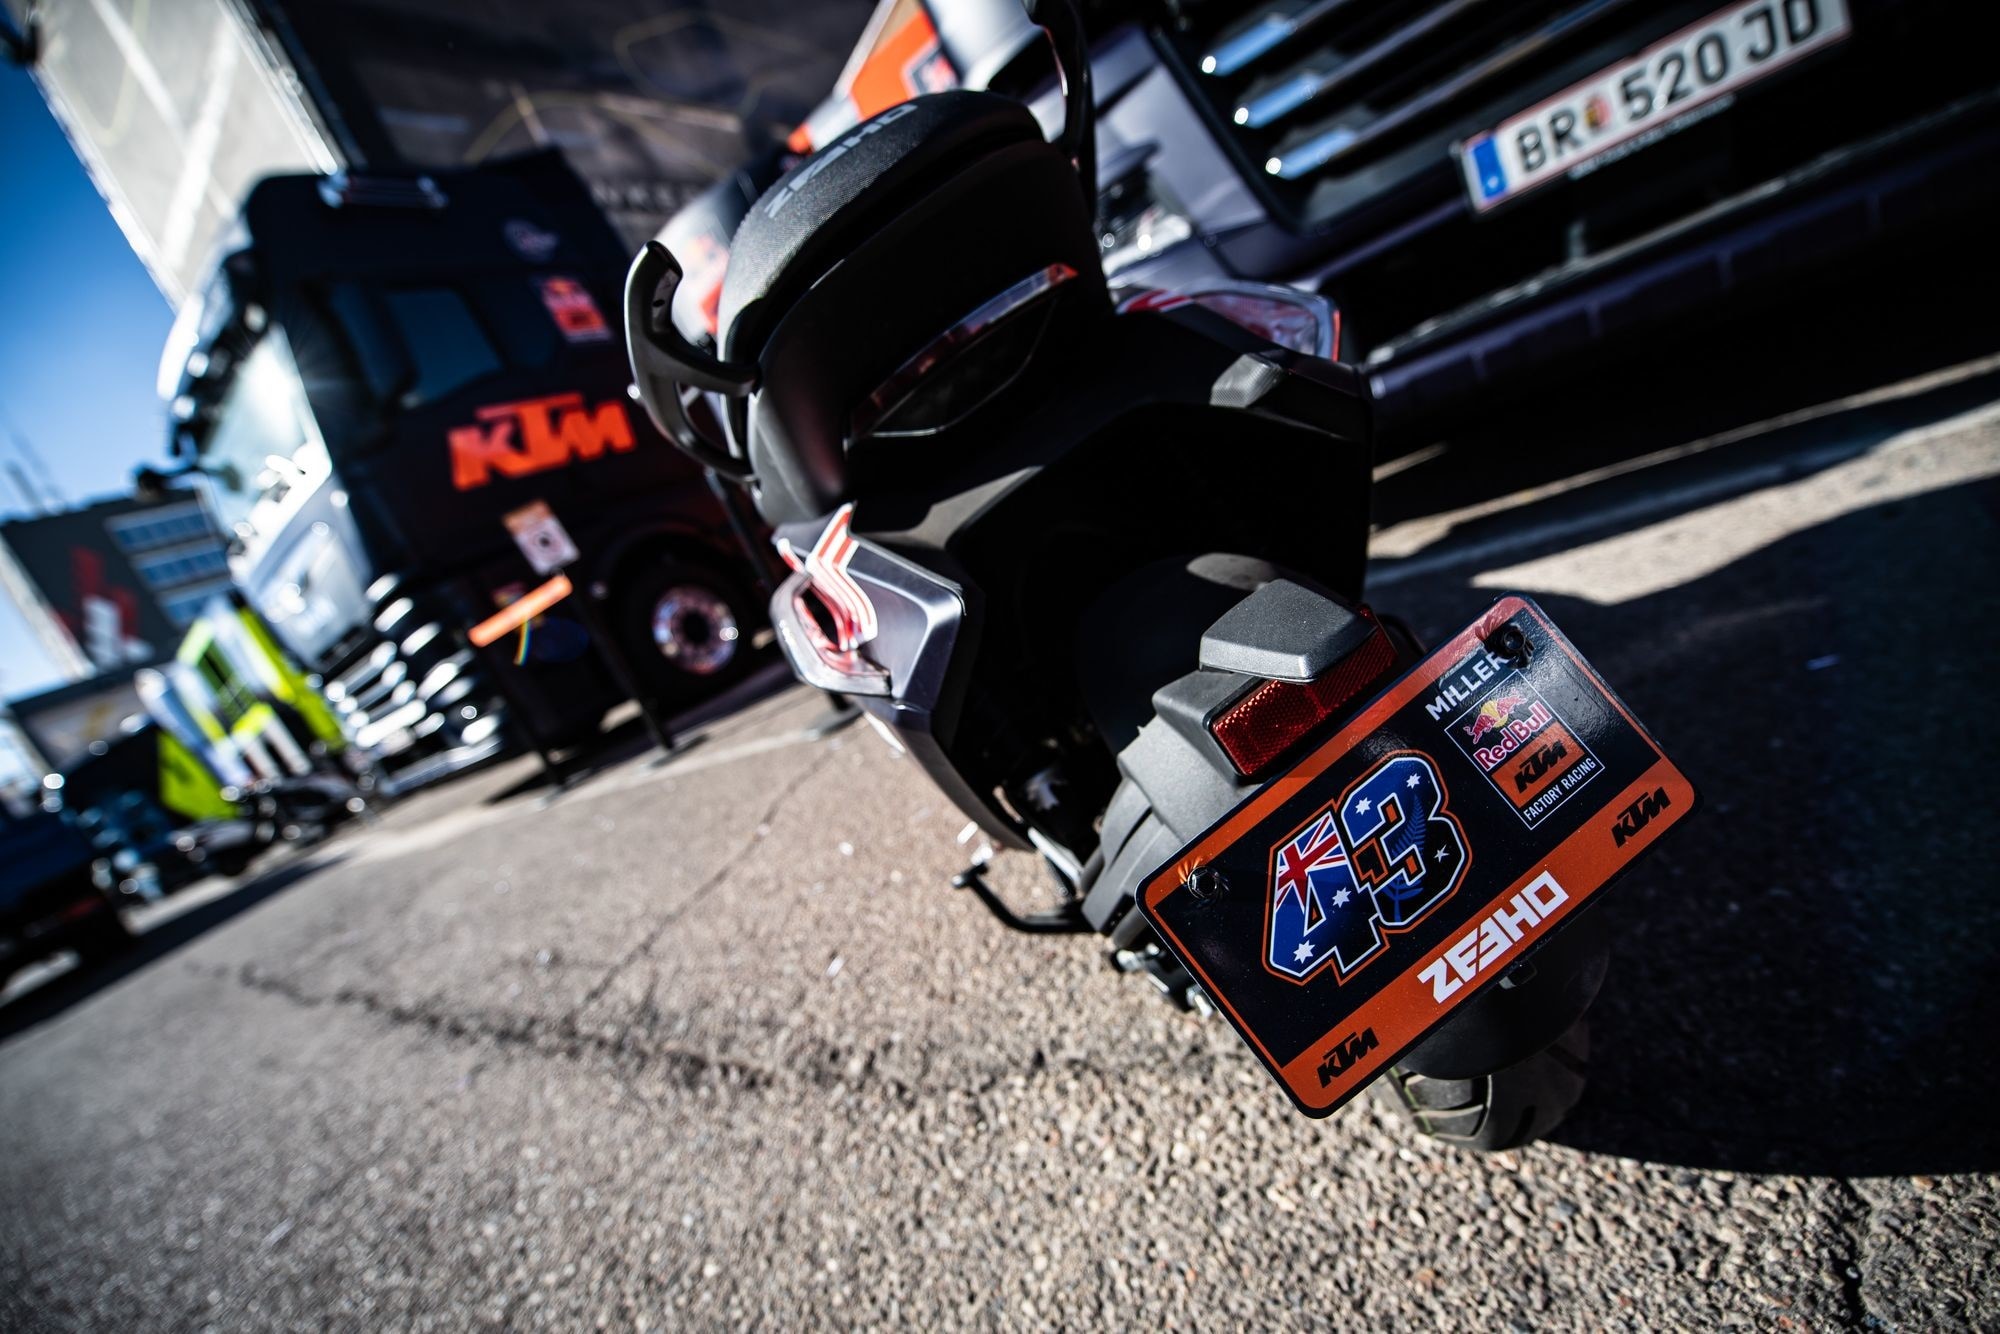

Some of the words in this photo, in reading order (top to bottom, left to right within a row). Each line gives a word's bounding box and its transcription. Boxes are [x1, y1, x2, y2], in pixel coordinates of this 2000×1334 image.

[1516, 106, 1578, 172] BR
[1619, 33, 1729, 121] 520
[1742, 0, 1819, 61] JD
[449, 392, 635, 490] KTM
[1425, 652, 1509, 721] MILLER
[1514, 739, 1568, 793] KTM
[1523, 786, 1562, 821] FACTORY
[1561, 757, 1596, 790] RACING
[1611, 787, 1671, 848] KTM
[1265, 752, 1470, 985] 43
[1316, 1027, 1380, 1088] KTM
